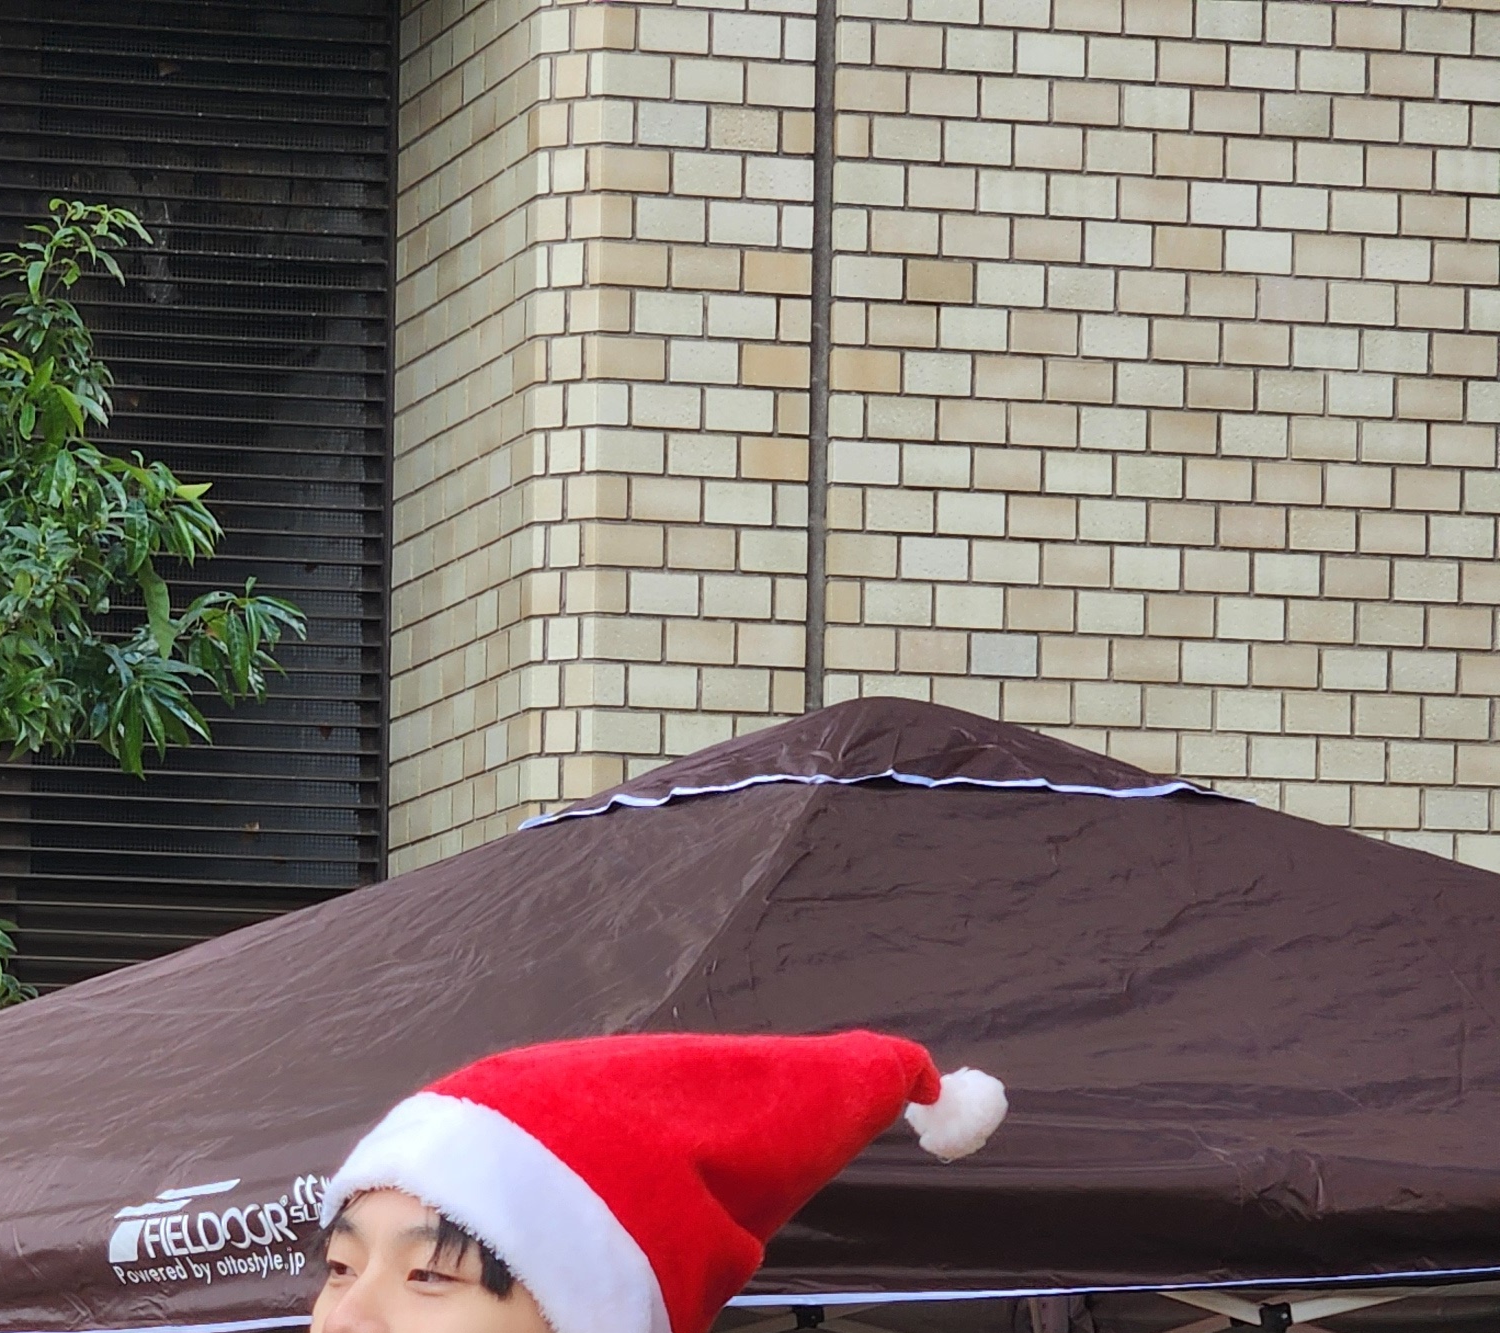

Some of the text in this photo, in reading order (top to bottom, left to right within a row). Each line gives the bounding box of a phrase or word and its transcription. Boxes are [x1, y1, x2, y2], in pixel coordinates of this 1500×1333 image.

[142, 1203, 298, 1259] FIELDOOR
[290, 1203, 322, 1223] SU
[113, 1246, 306, 1285] Powered by ottostyle.jp
